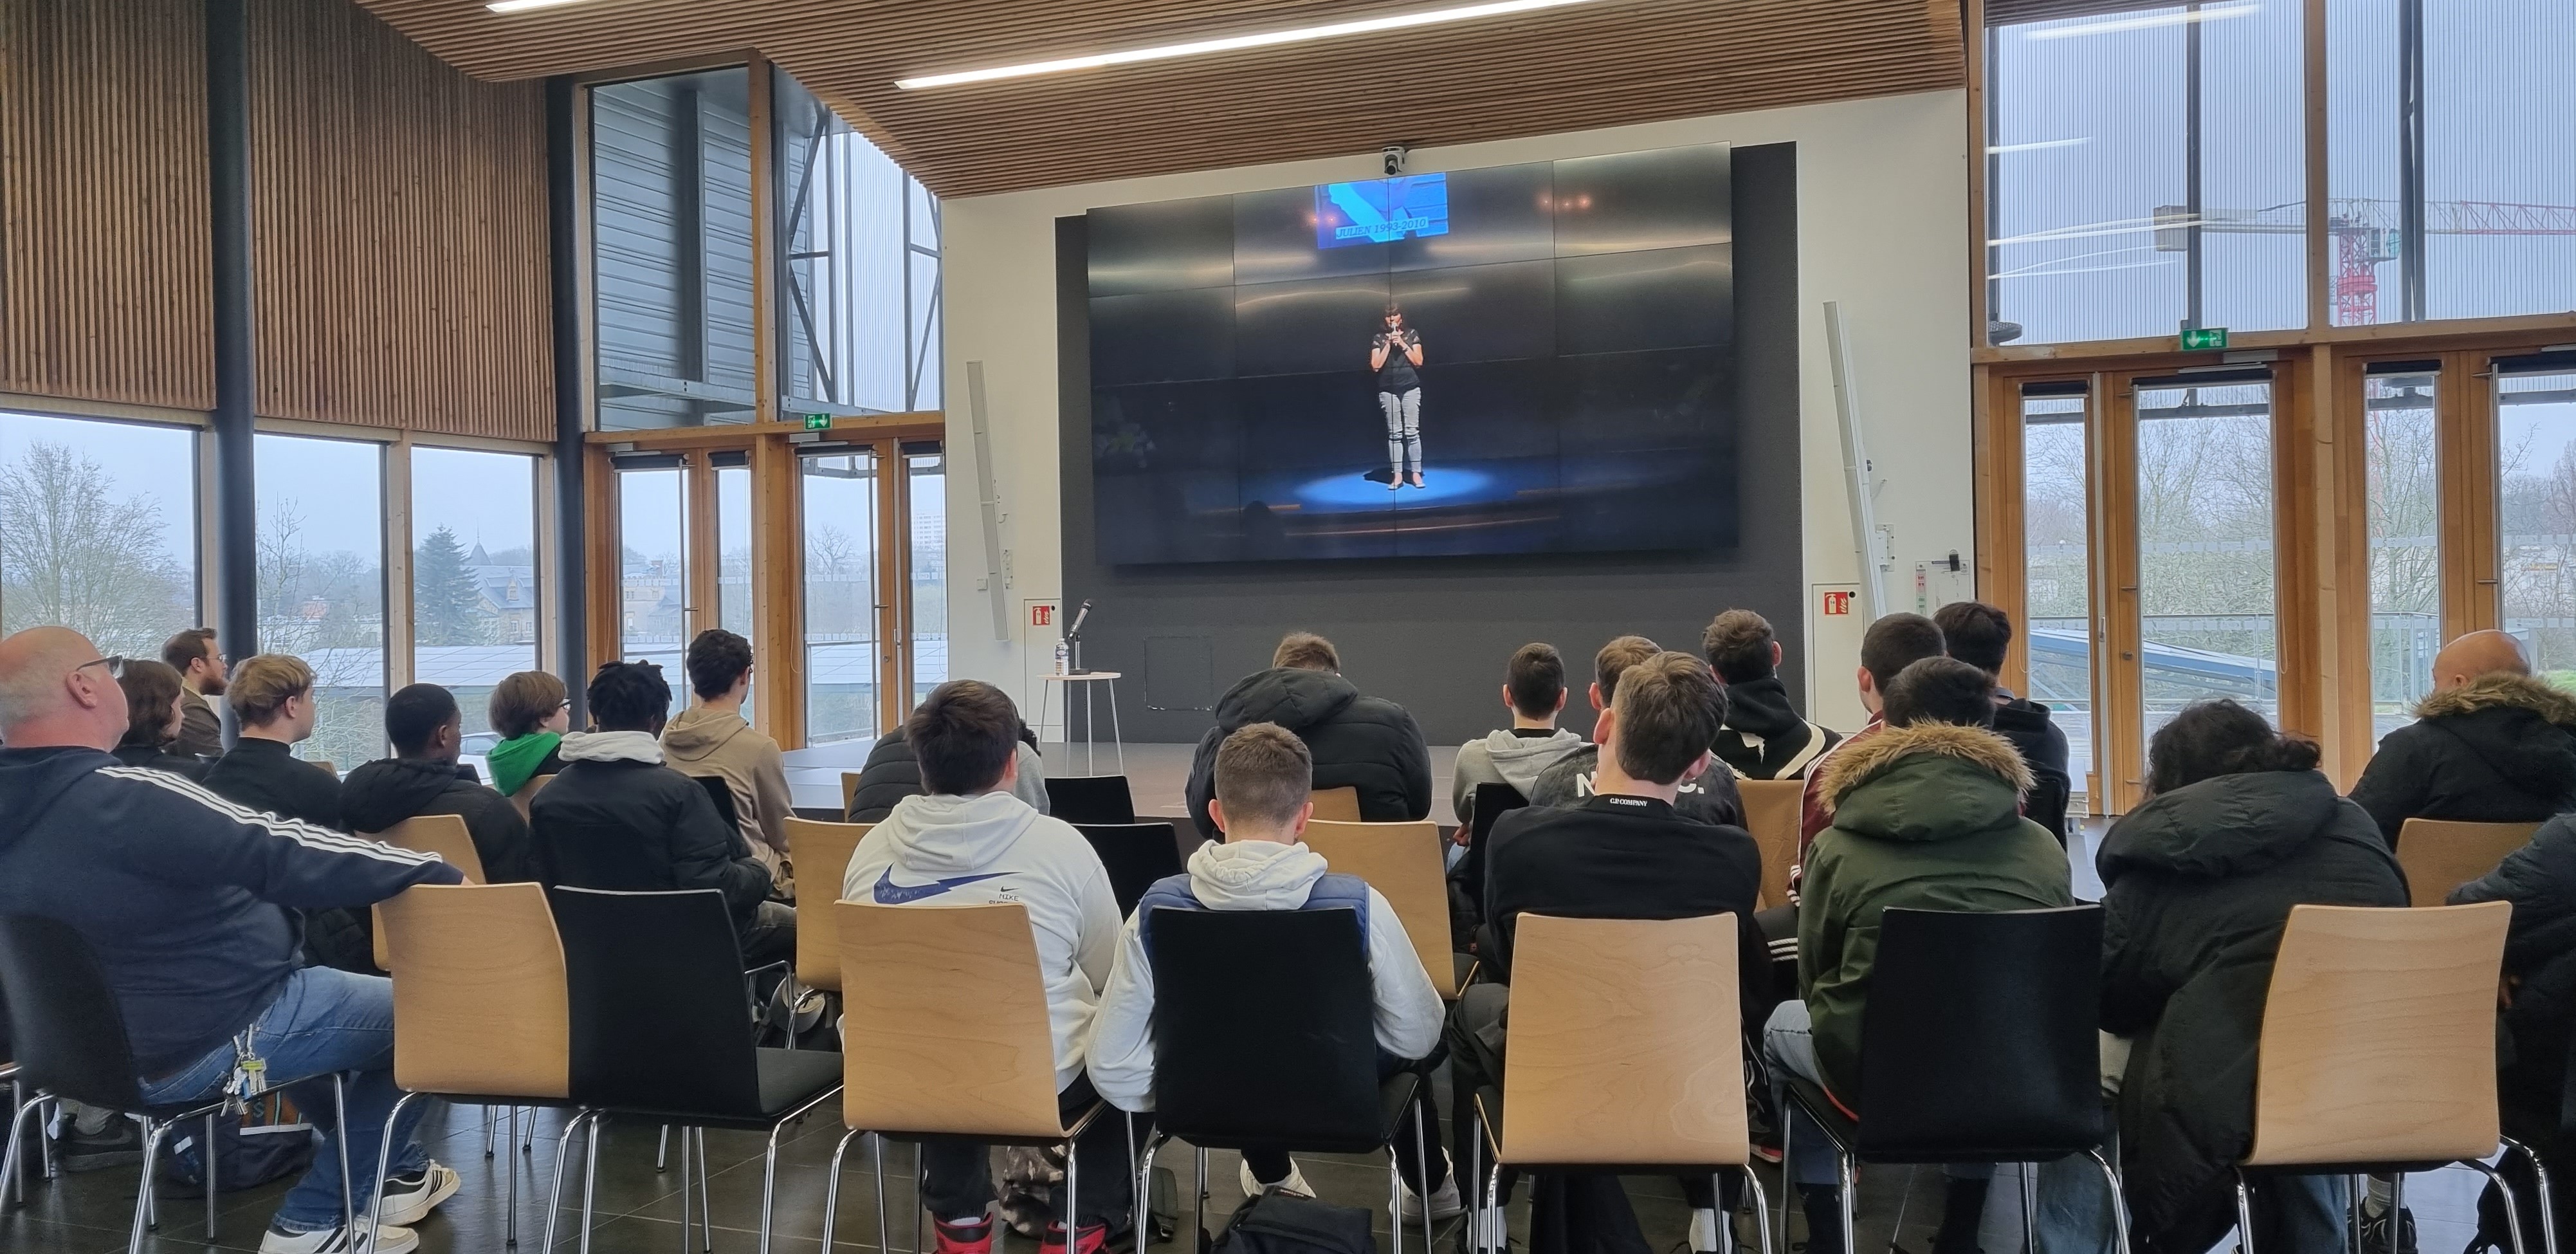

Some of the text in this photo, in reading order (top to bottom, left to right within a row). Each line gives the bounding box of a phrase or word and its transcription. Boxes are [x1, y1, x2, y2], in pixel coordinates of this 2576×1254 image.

[1337, 218, 1426, 237] JULIEN 1993-2010
[999, 893, 1019, 901] NIKE
